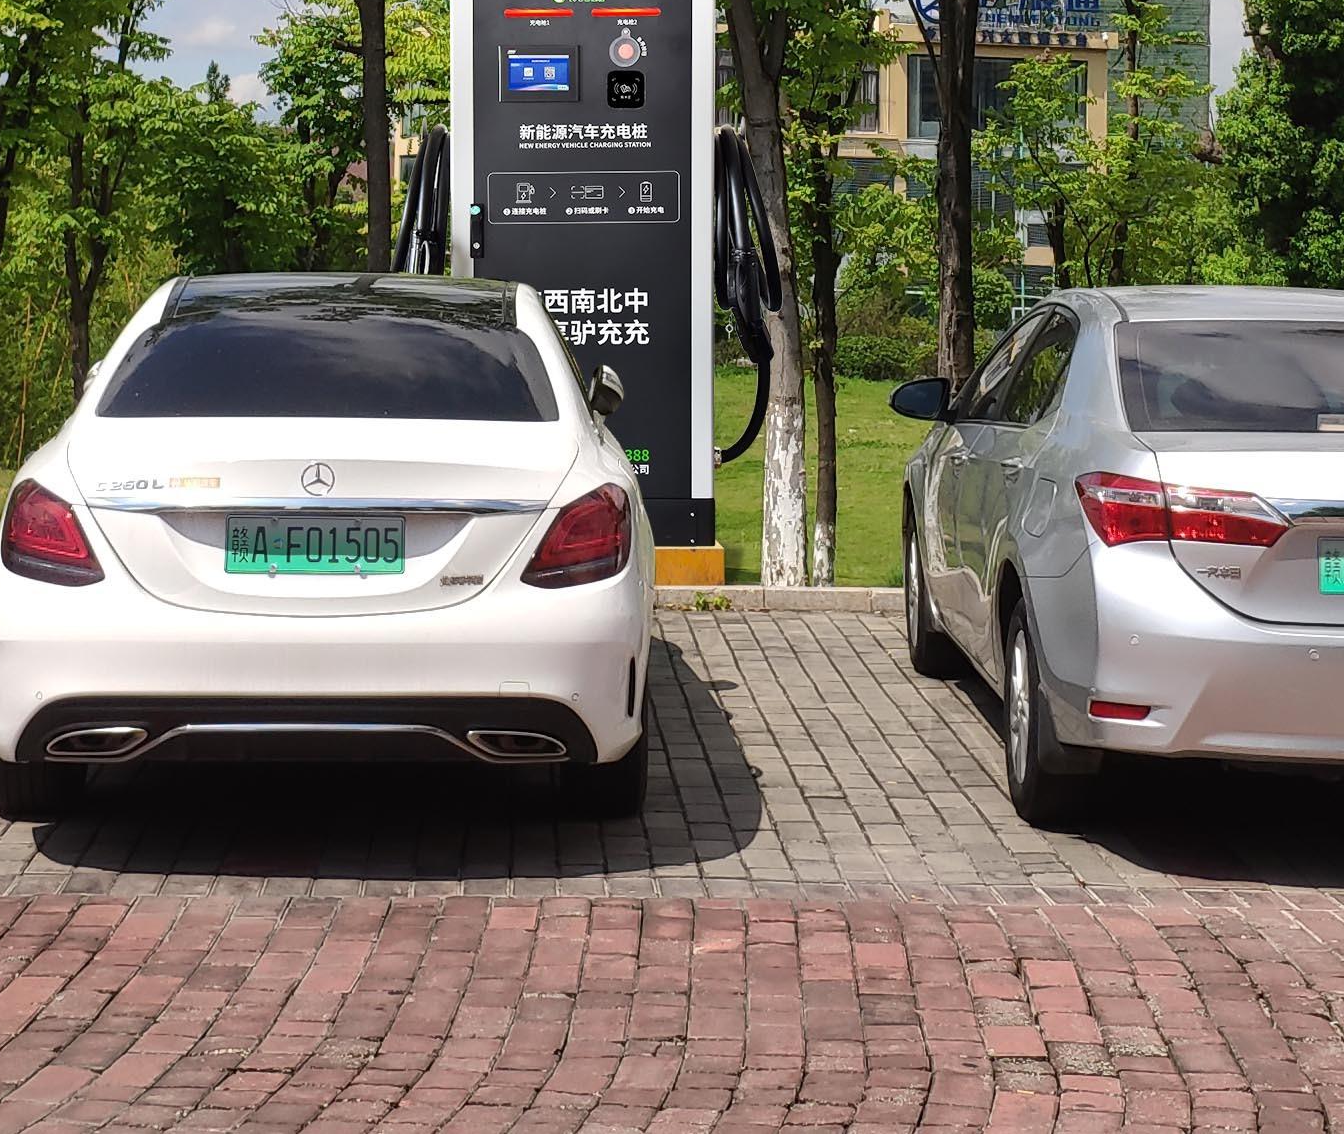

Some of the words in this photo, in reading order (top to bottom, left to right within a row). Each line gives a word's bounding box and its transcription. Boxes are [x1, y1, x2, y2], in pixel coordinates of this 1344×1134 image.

[519, 123, 648, 140] 新能源汽车充电桩
[538, 288, 649, 314] 西南北中
